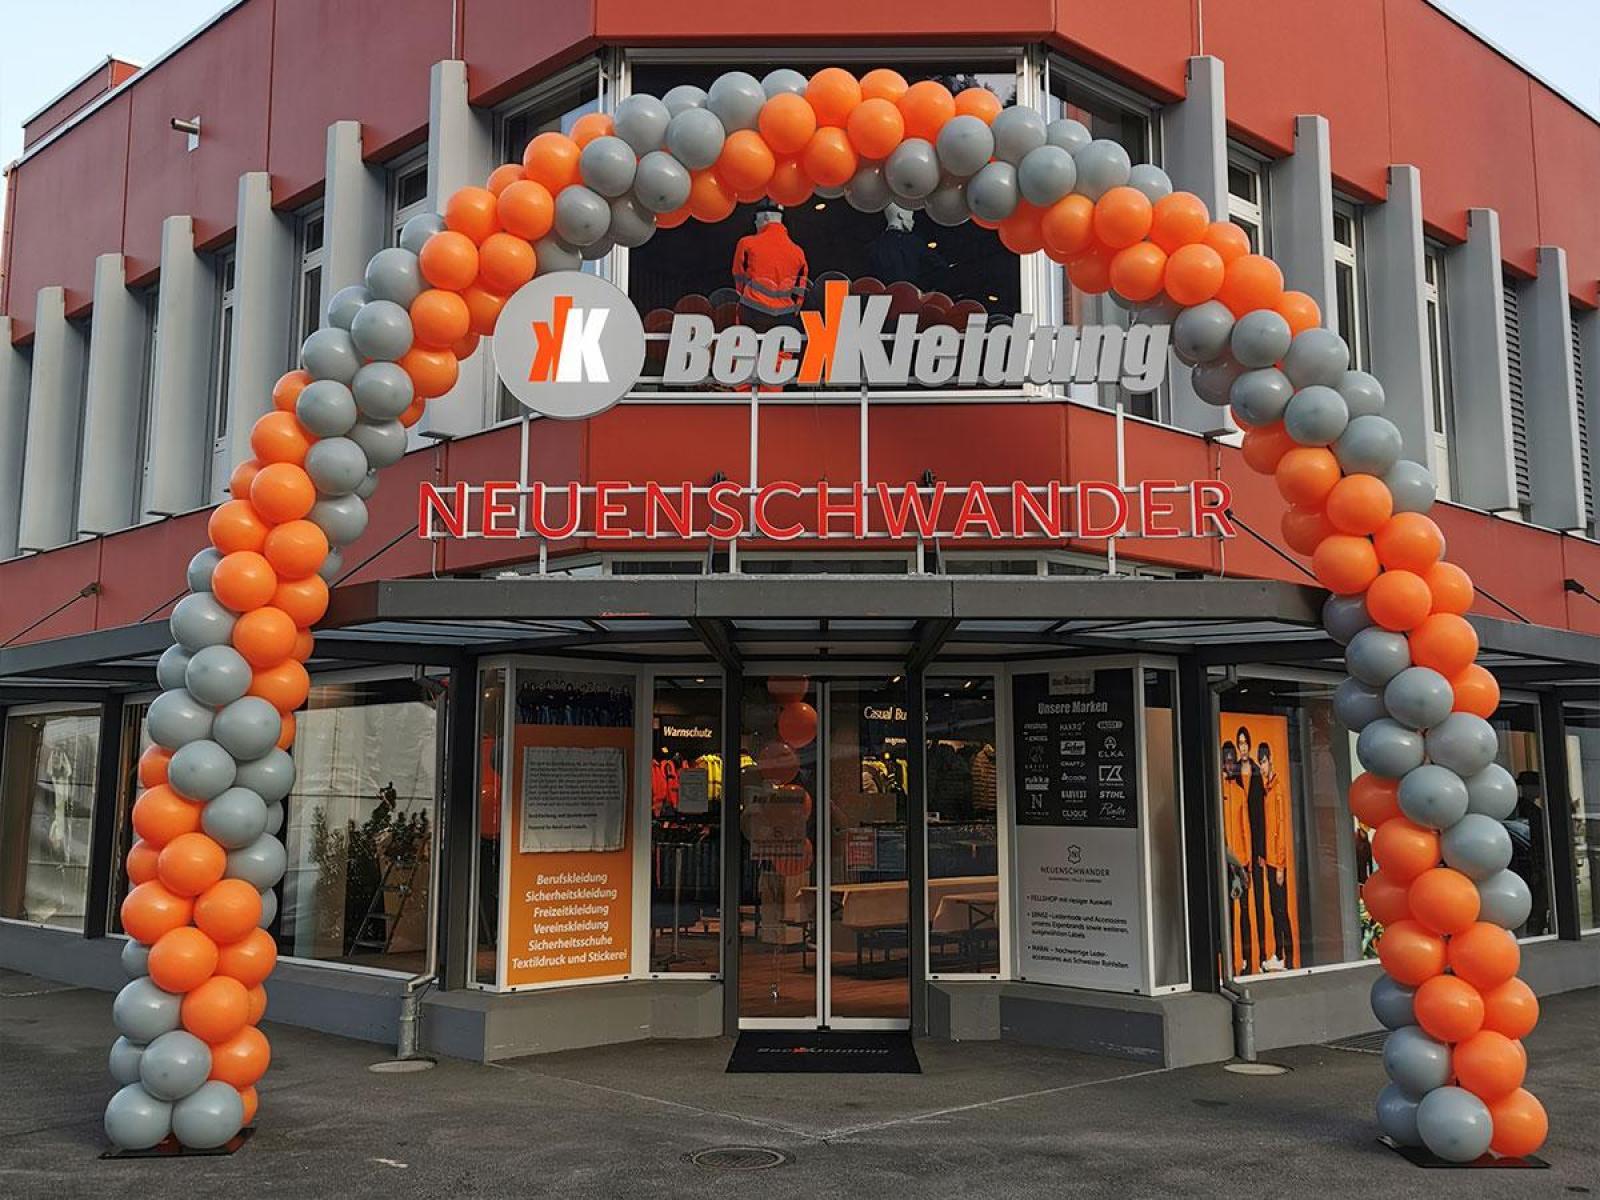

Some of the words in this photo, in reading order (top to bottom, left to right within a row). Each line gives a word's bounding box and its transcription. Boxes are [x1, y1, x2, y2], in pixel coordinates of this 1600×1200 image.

[419, 480, 1237, 540] NEUENSCHWANDER
[1072, 700, 1108, 713] Marken
[663, 726, 713, 738] Warnschutz
[536, 871, 608, 885] Berufskleidung
[525, 888, 617, 902] Sicherheitskleidung
[533, 904, 609, 918] Freizeitkleidung
[533, 920, 609, 934] Vereinskleidung
[528, 935, 613, 951] Sicherheitsschuhe
[511, 954, 566, 969] Textildruck
[568, 951, 587, 964] und
[588, 949, 628, 962] Stickerei
